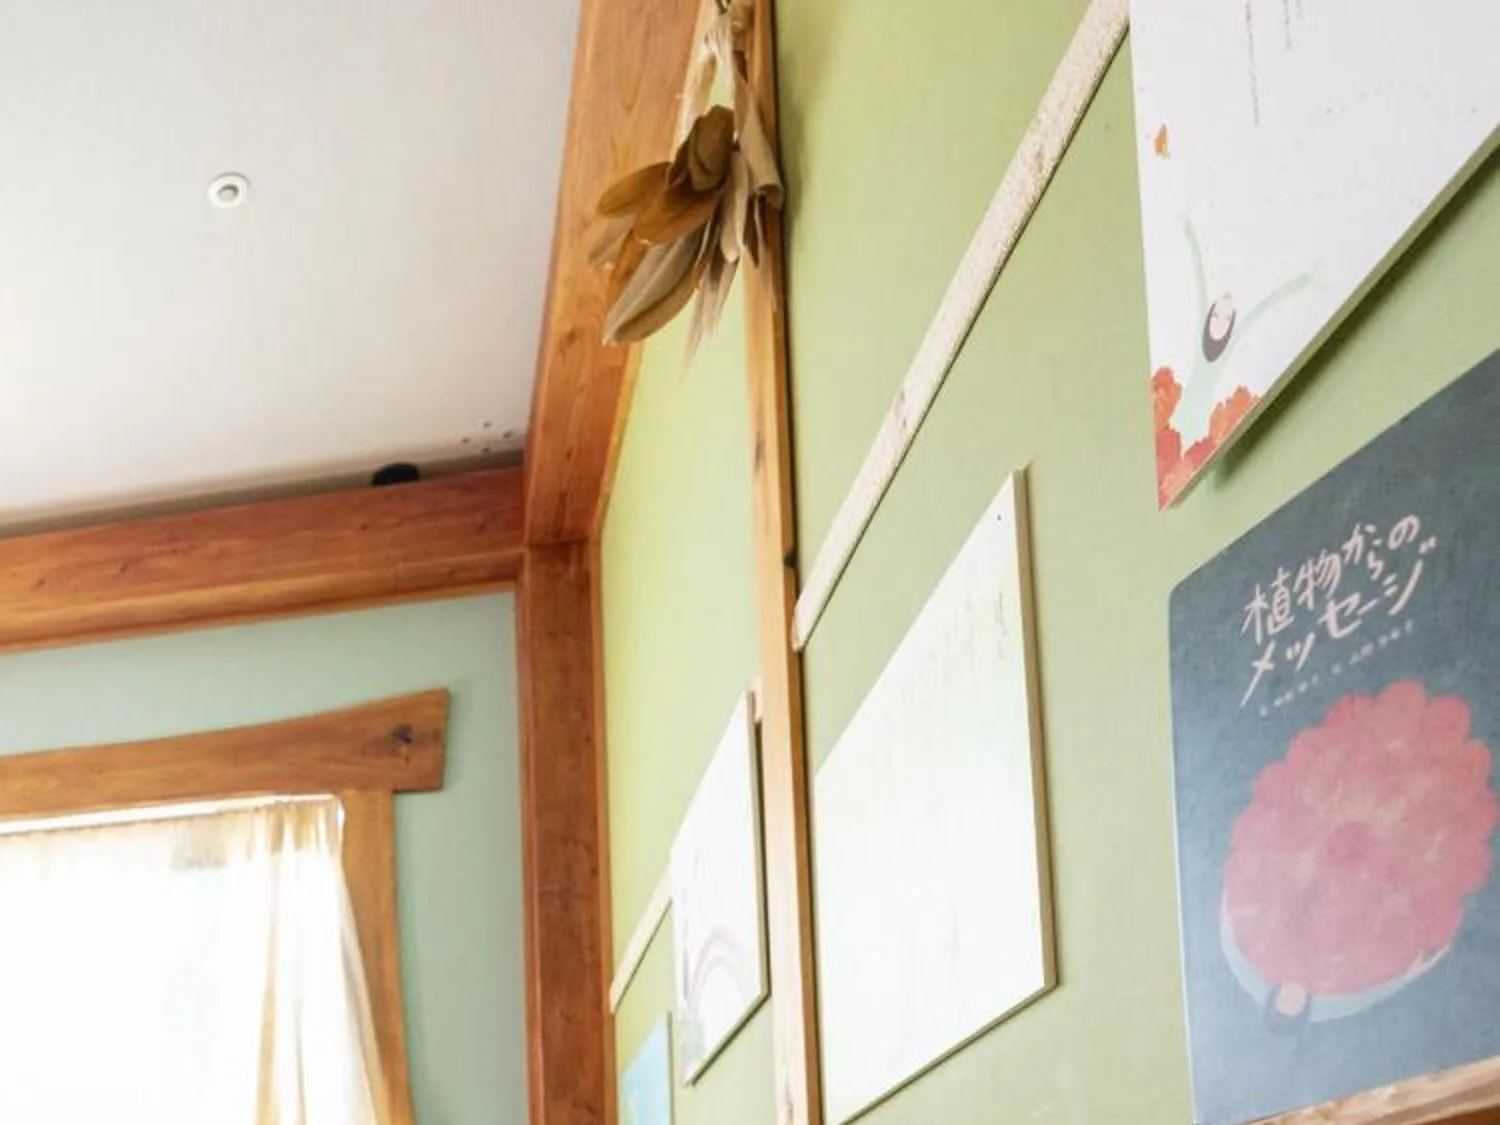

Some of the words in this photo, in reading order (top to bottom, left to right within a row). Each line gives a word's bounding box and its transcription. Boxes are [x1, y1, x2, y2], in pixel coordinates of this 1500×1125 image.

[1239, 535, 1438, 709] メッセージ
[1240, 514, 1421, 646] 植物からの
